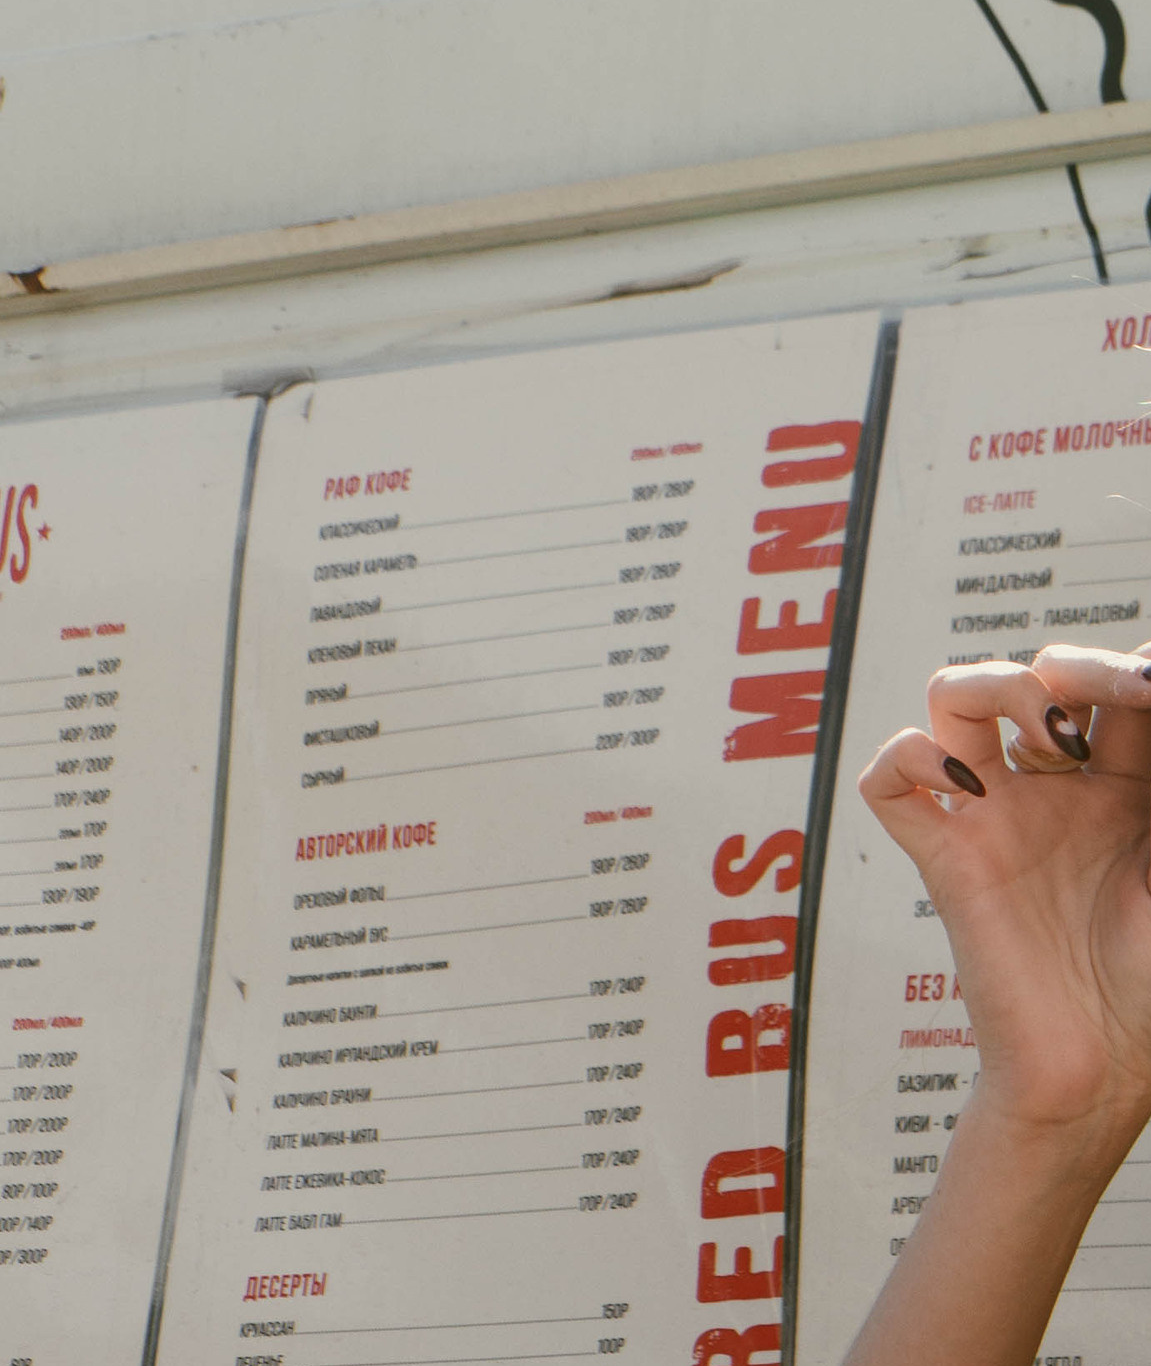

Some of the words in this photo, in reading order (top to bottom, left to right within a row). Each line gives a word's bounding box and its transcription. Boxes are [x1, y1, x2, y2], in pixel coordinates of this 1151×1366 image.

[968, 435, 982, 462] С
[988, 428, 1048, 461] КОФЕ
[323, 475, 361, 501] РАФ
[364, 467, 413, 496] КОФЕ
[958, 528, 1062, 556] КЛАССИЧЕСКИЙ
[723, 420, 863, 763] MENU
[955, 567, 1053, 596] МИНДАЛЬНЫЙ
[952, 609, 1030, 635] КЛУБНИЧНО
[1043, 600, 1141, 629] ЛАВАНДОВЫЙ
[295, 823, 388, 862] АВТОРСКИЙ
[393, 821, 437, 850] КОФЕ
[706, 829, 806, 1078] BUS
[904, 973, 946, 1003] БЕЗ
[897, 1073, 958, 1093] БАЗИЛИК
[895, 1115, 931, 1134] КИВИ
[893, 1154, 939, 1174] МАНГО
[891, 1196, 930, 1215] АРБУ
[242, 1272, 328, 1303] ДЕСЕРТЫ
[239, 1320, 296, 1339] КРУАССАН
